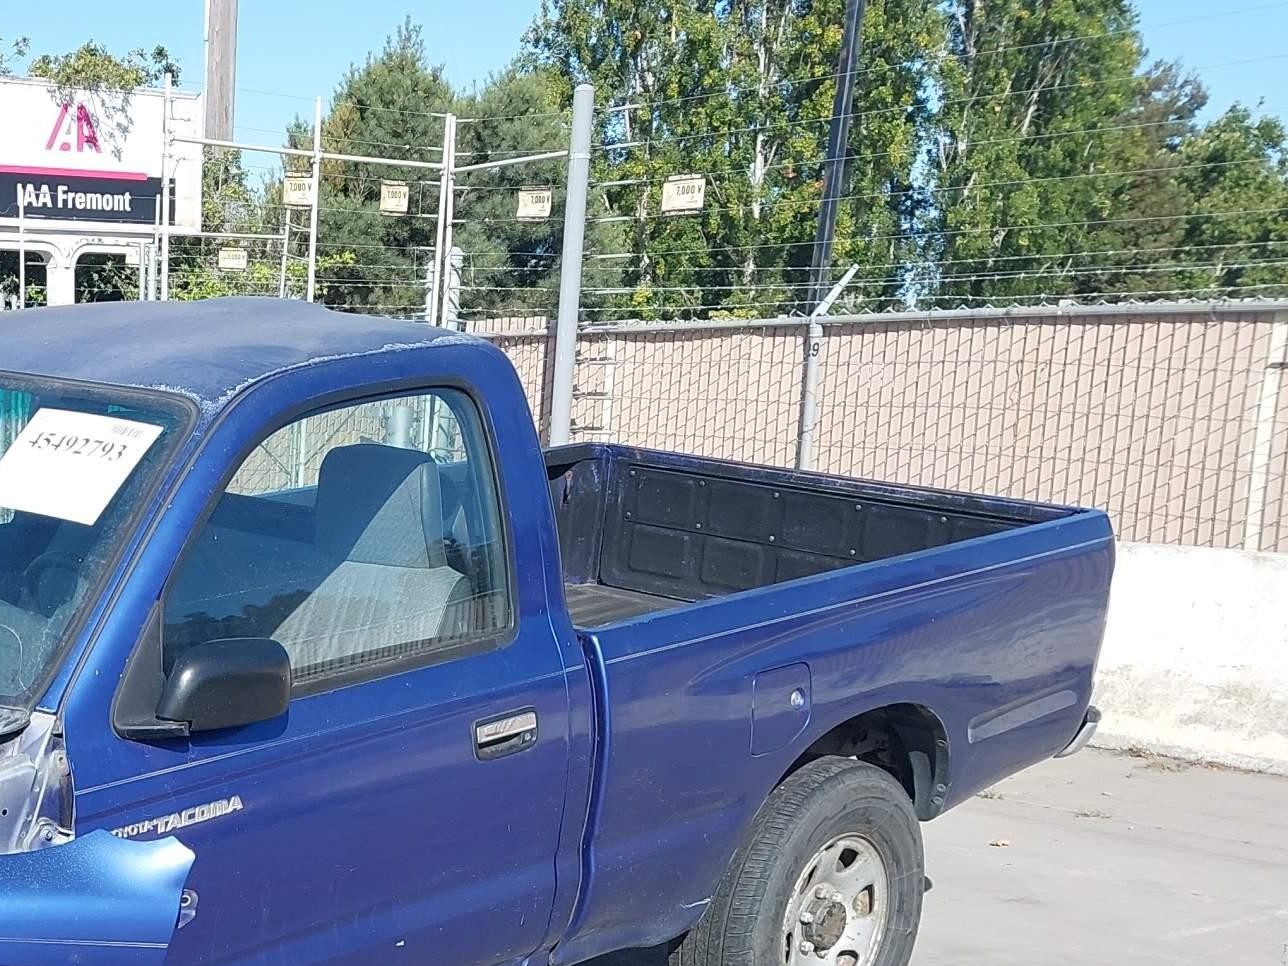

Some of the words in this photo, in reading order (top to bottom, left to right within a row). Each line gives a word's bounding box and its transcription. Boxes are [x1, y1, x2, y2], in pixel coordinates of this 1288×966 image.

[16, 183, 53, 207] IAA
[57, 185, 132, 211] Fremont
[676, 185, 695, 196] 7,000
[28, 432, 128, 461] 45492793
[110, 820, 153, 838] OYOTA
[154, 795, 244, 834] TACOMA
